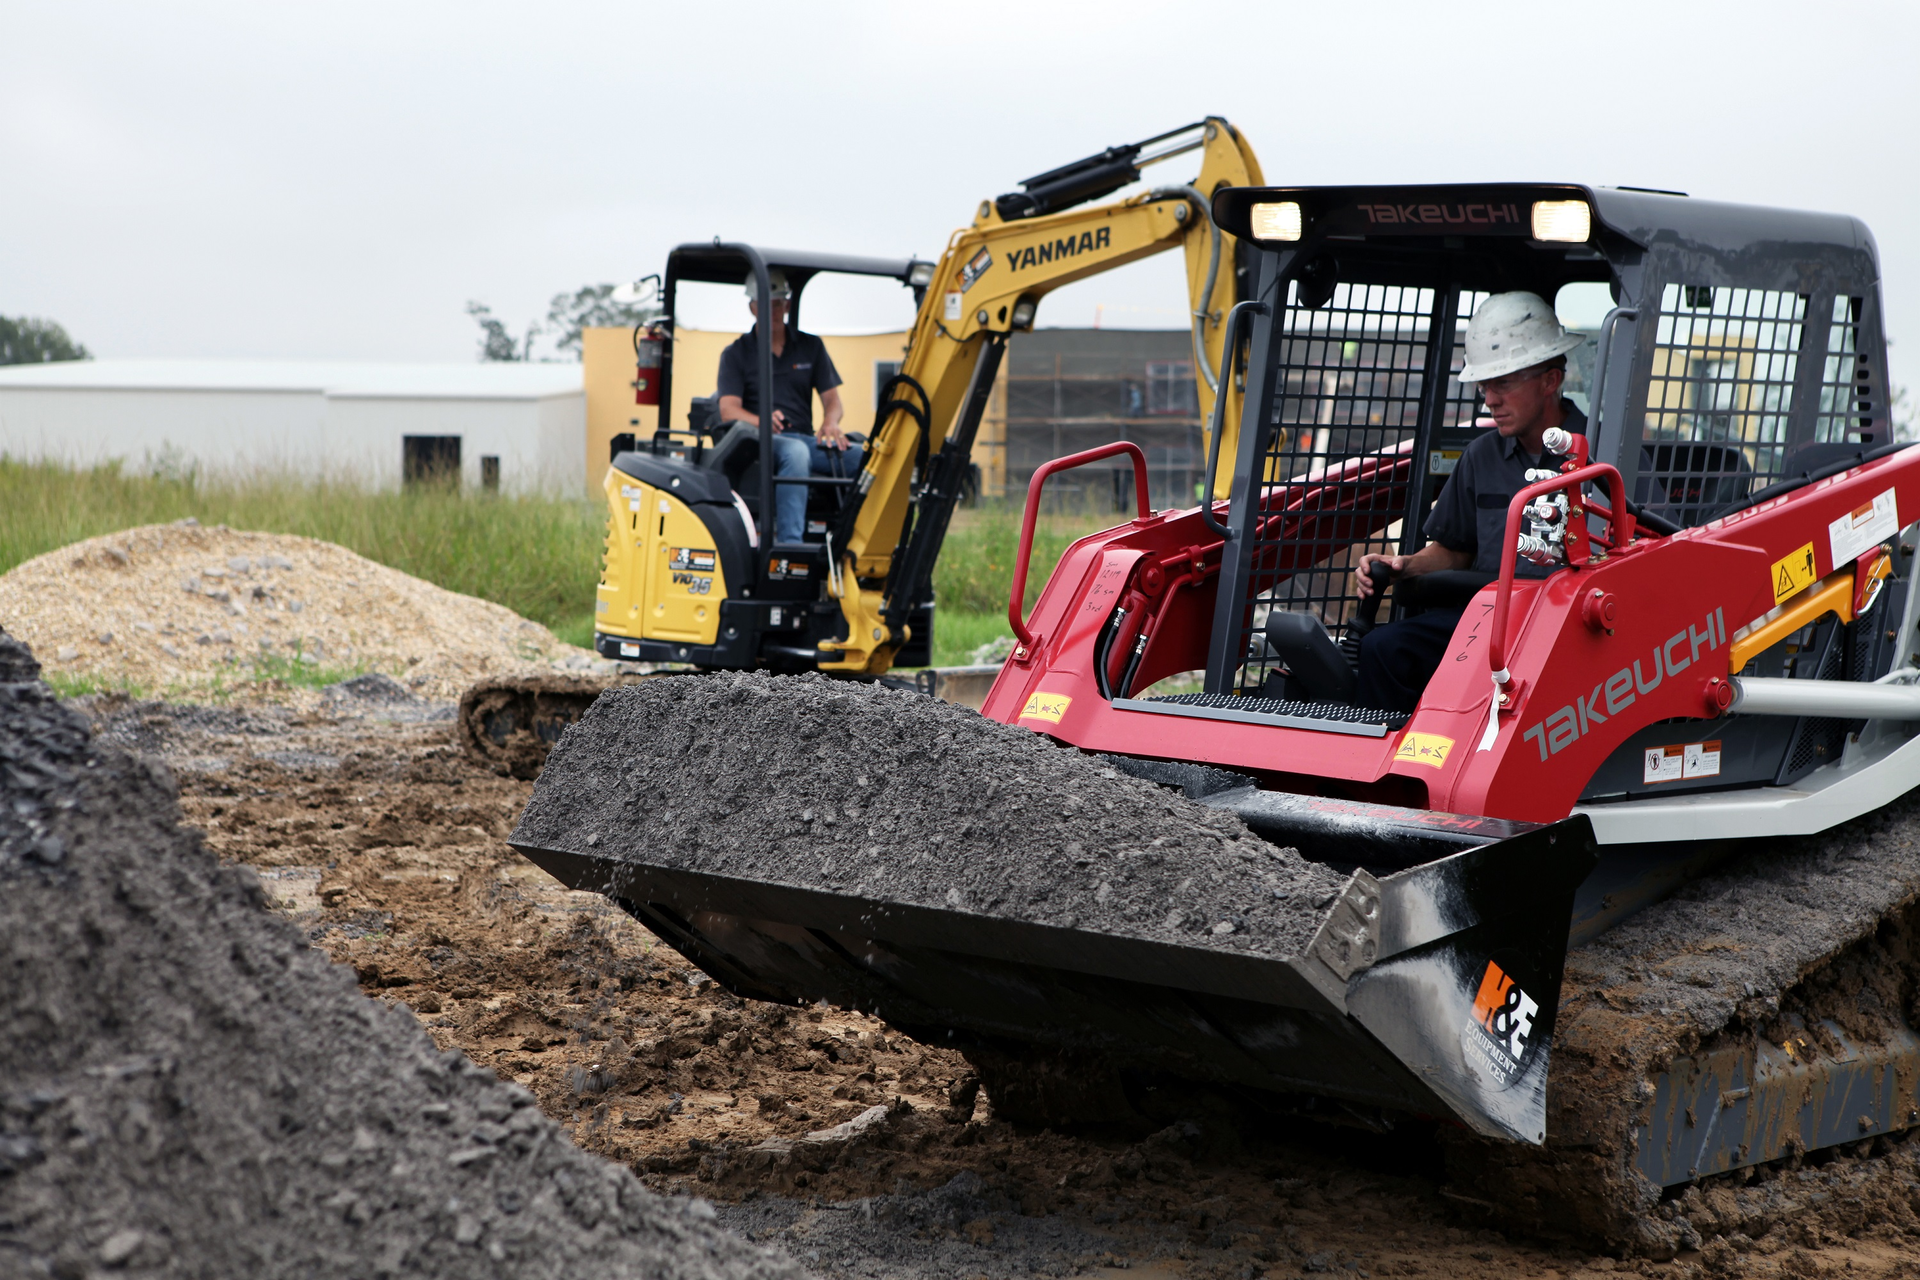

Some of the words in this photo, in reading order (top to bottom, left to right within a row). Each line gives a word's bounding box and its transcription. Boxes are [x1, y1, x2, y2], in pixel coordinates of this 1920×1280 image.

[1006, 226, 1110, 272] YANMAR
[1464, 1036, 1506, 1084] SERVICES
[1465, 1018, 1517, 1074] EQUIPMENT
